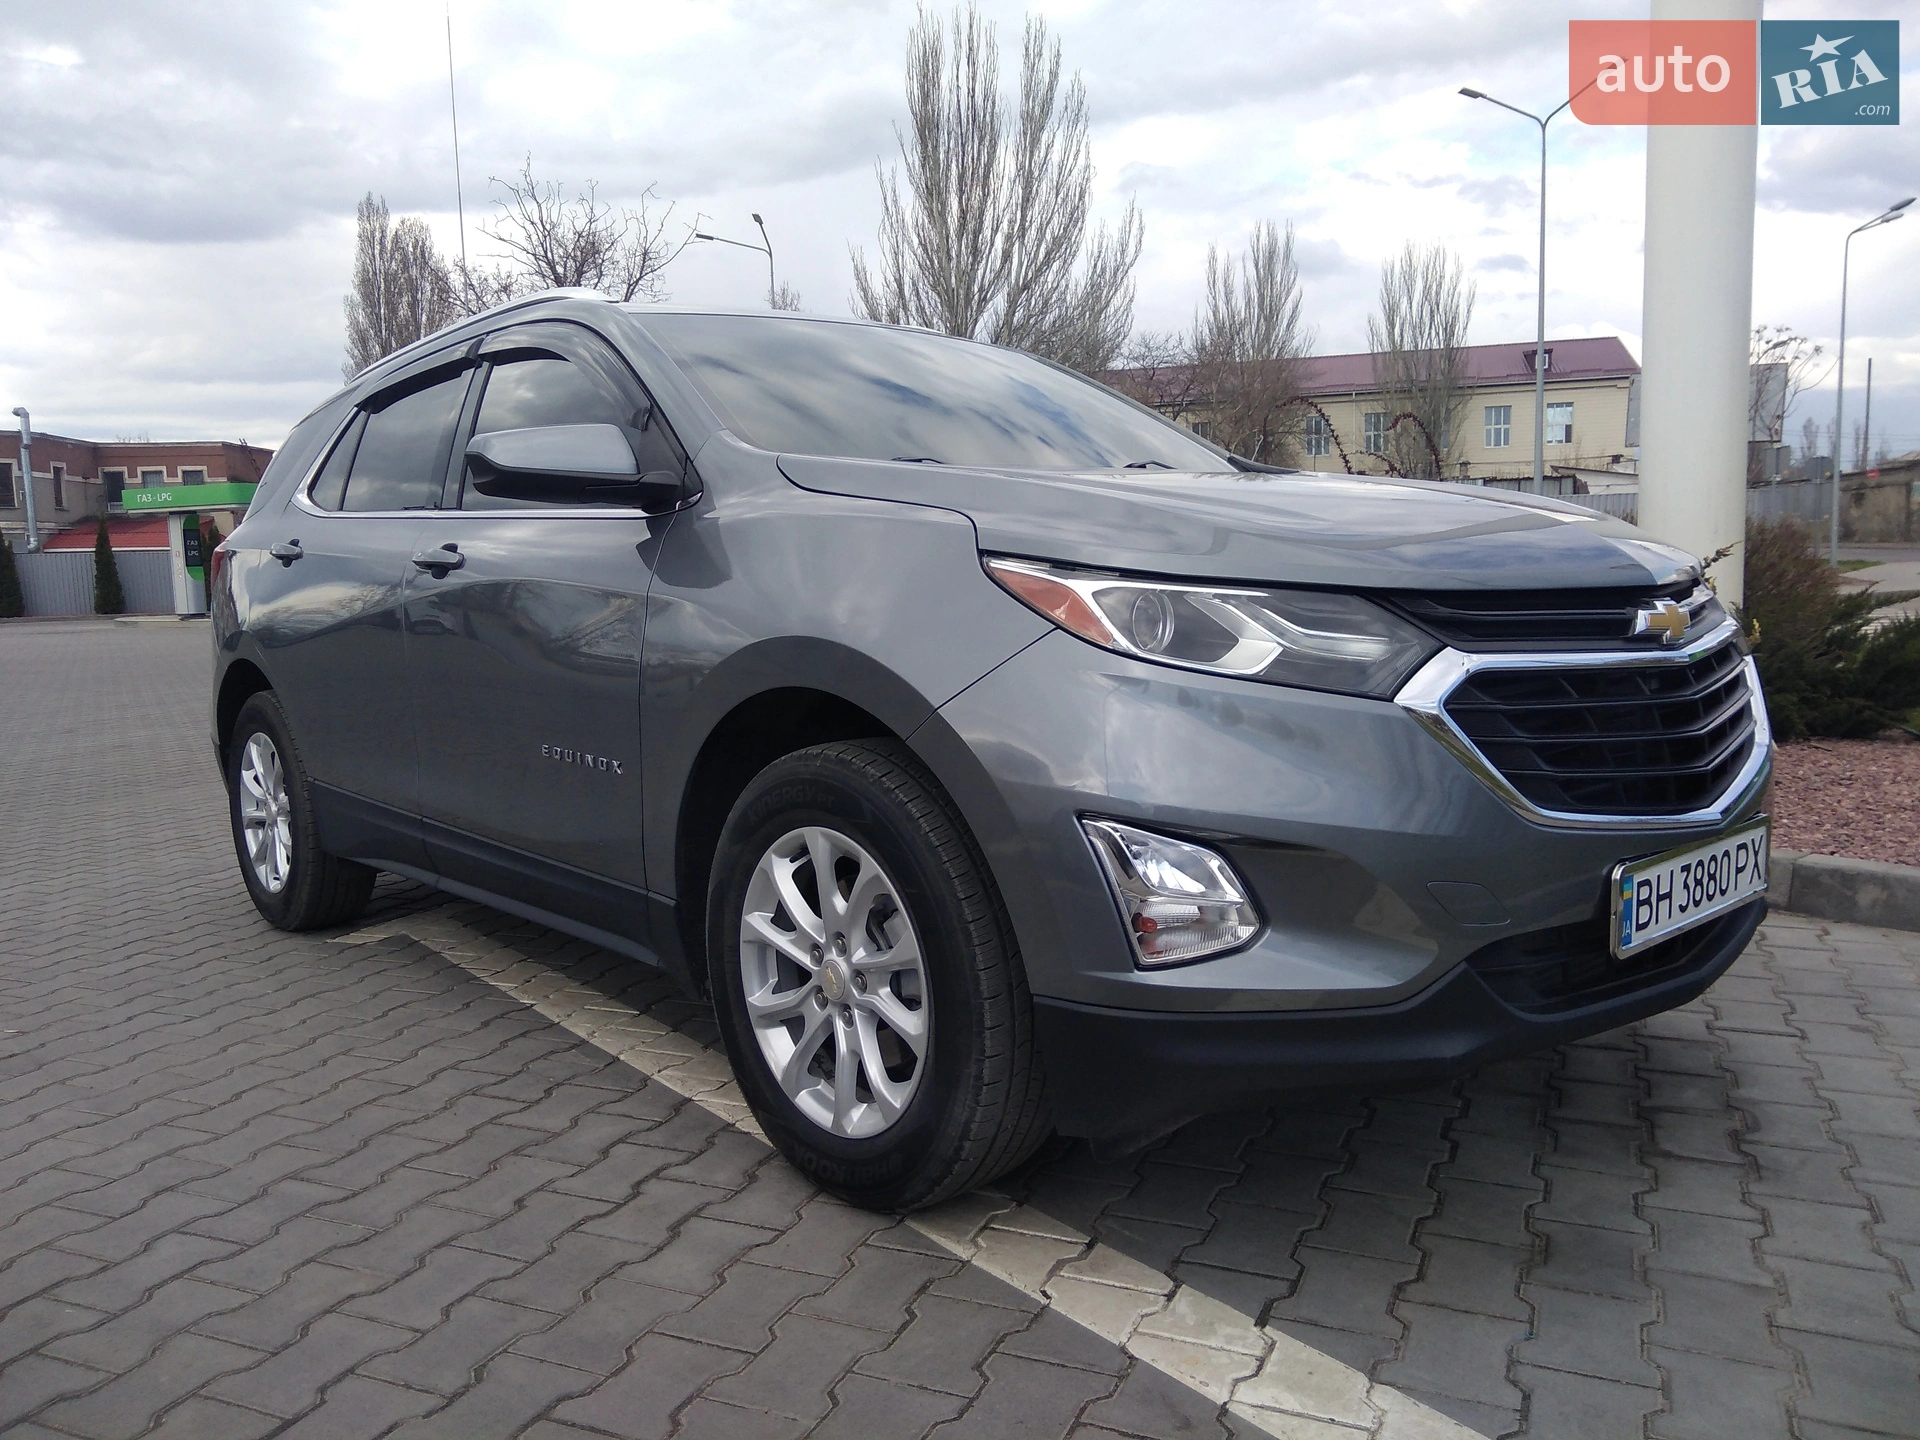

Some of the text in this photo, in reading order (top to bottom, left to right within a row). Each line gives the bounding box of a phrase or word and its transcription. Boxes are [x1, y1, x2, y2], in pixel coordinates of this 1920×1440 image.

[157, 492, 172, 502] LPG
[541, 743, 624, 775] EQUINOX
[1635, 834, 1763, 932] BH 3880 PX
